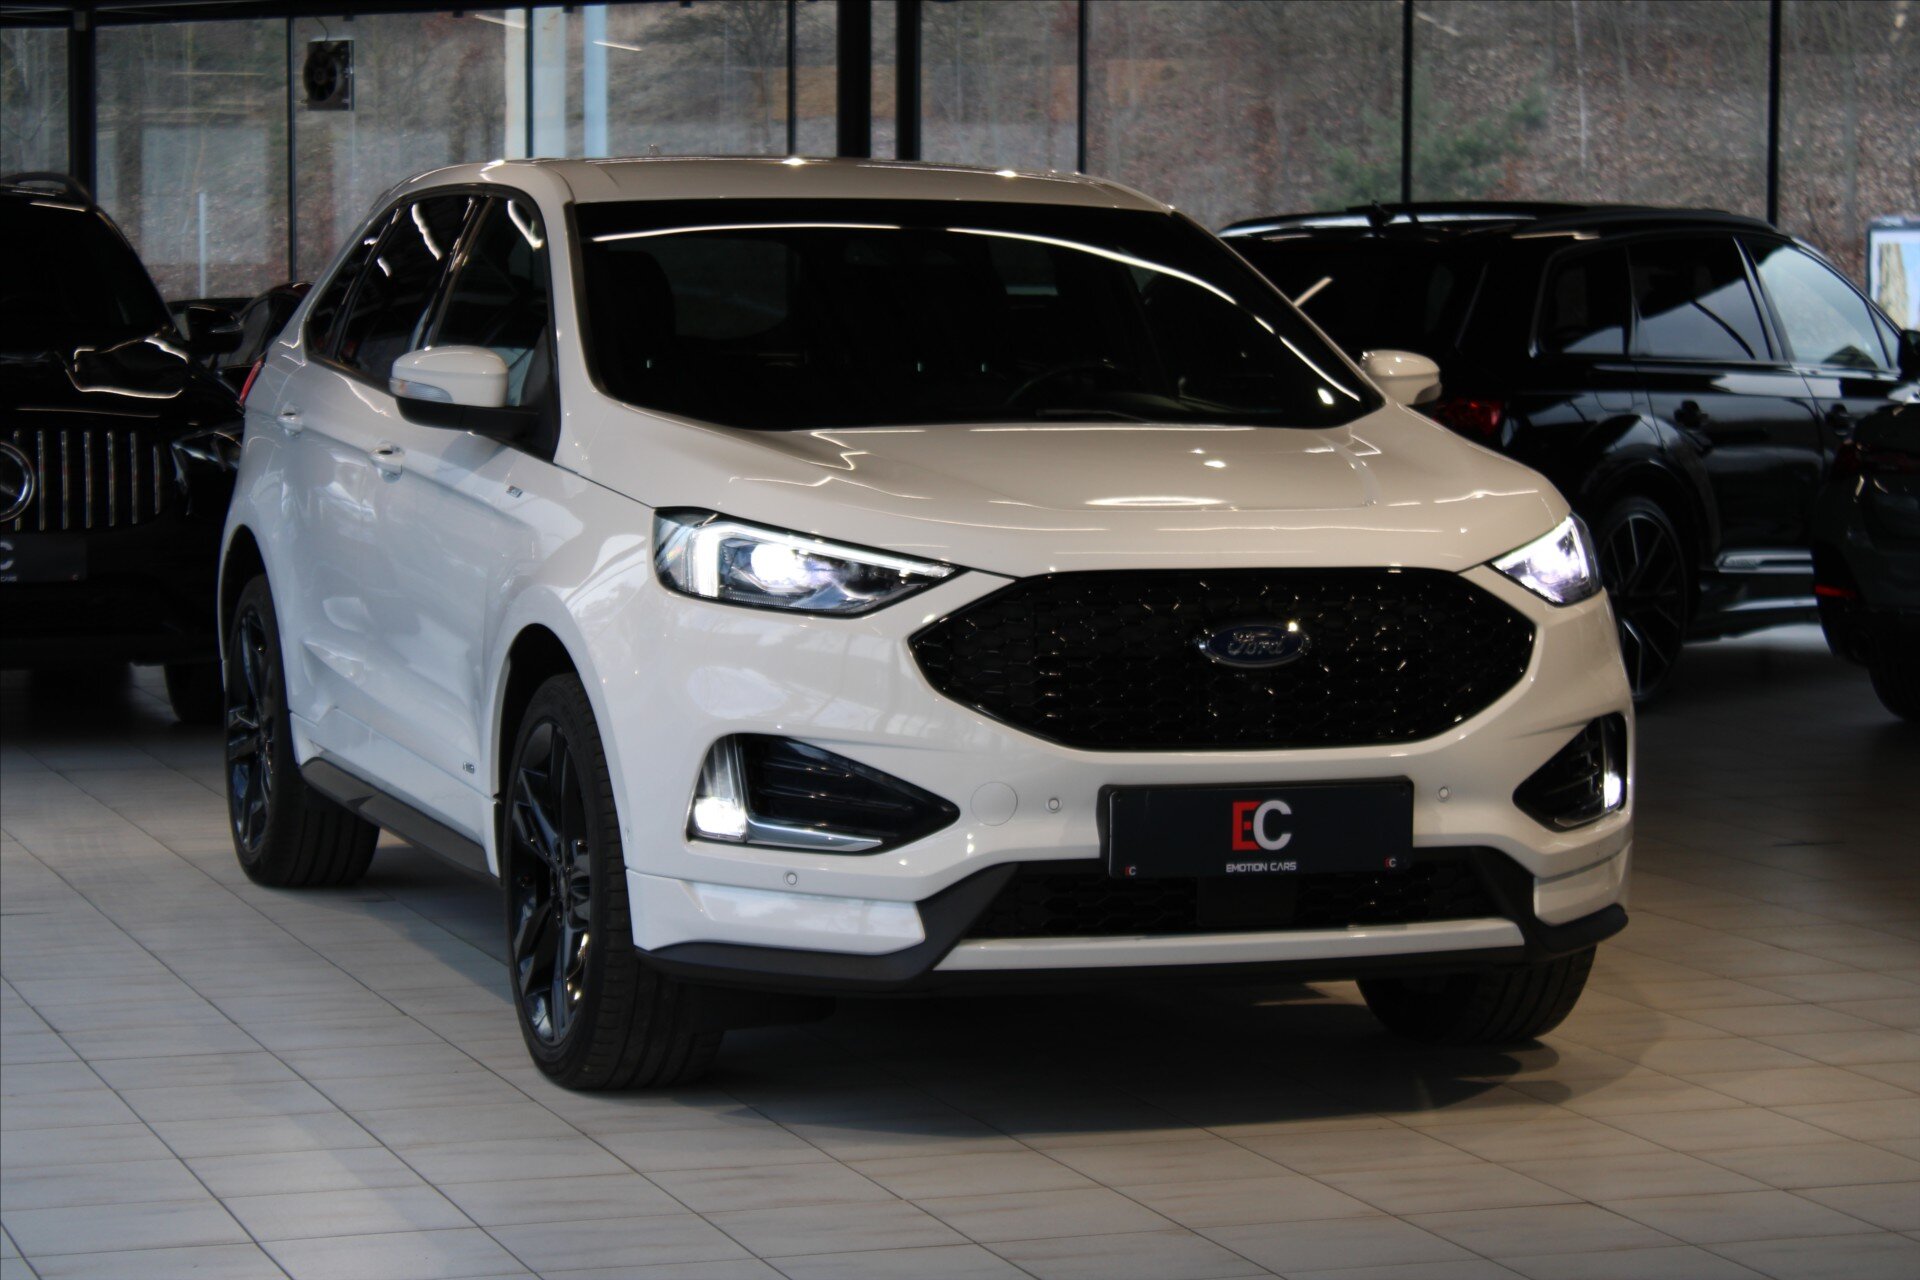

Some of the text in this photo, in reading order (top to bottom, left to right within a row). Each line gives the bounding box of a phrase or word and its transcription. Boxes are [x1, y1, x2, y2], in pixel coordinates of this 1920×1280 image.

[1227, 631, 1287, 656] Ford
[1232, 799, 1292, 851] EC
[1226, 861, 1297, 873] EMOTION CARS
